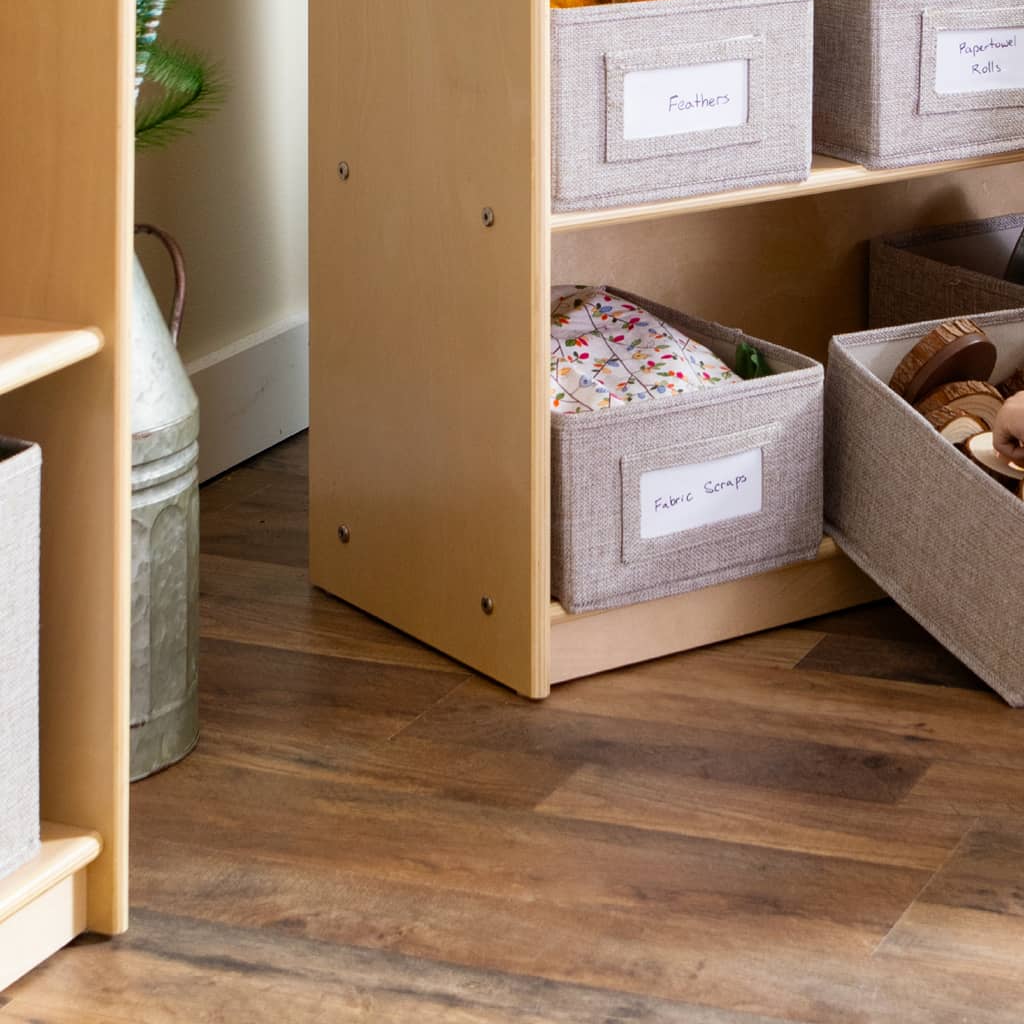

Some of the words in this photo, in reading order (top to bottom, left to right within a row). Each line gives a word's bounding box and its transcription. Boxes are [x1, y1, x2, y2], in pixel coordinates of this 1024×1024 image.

[971, 60, 1002, 74] Rolls
[668, 93, 730, 112] Feathers
[654, 492, 694, 512] Fabric
[704, 474, 748, 494] Scraps
